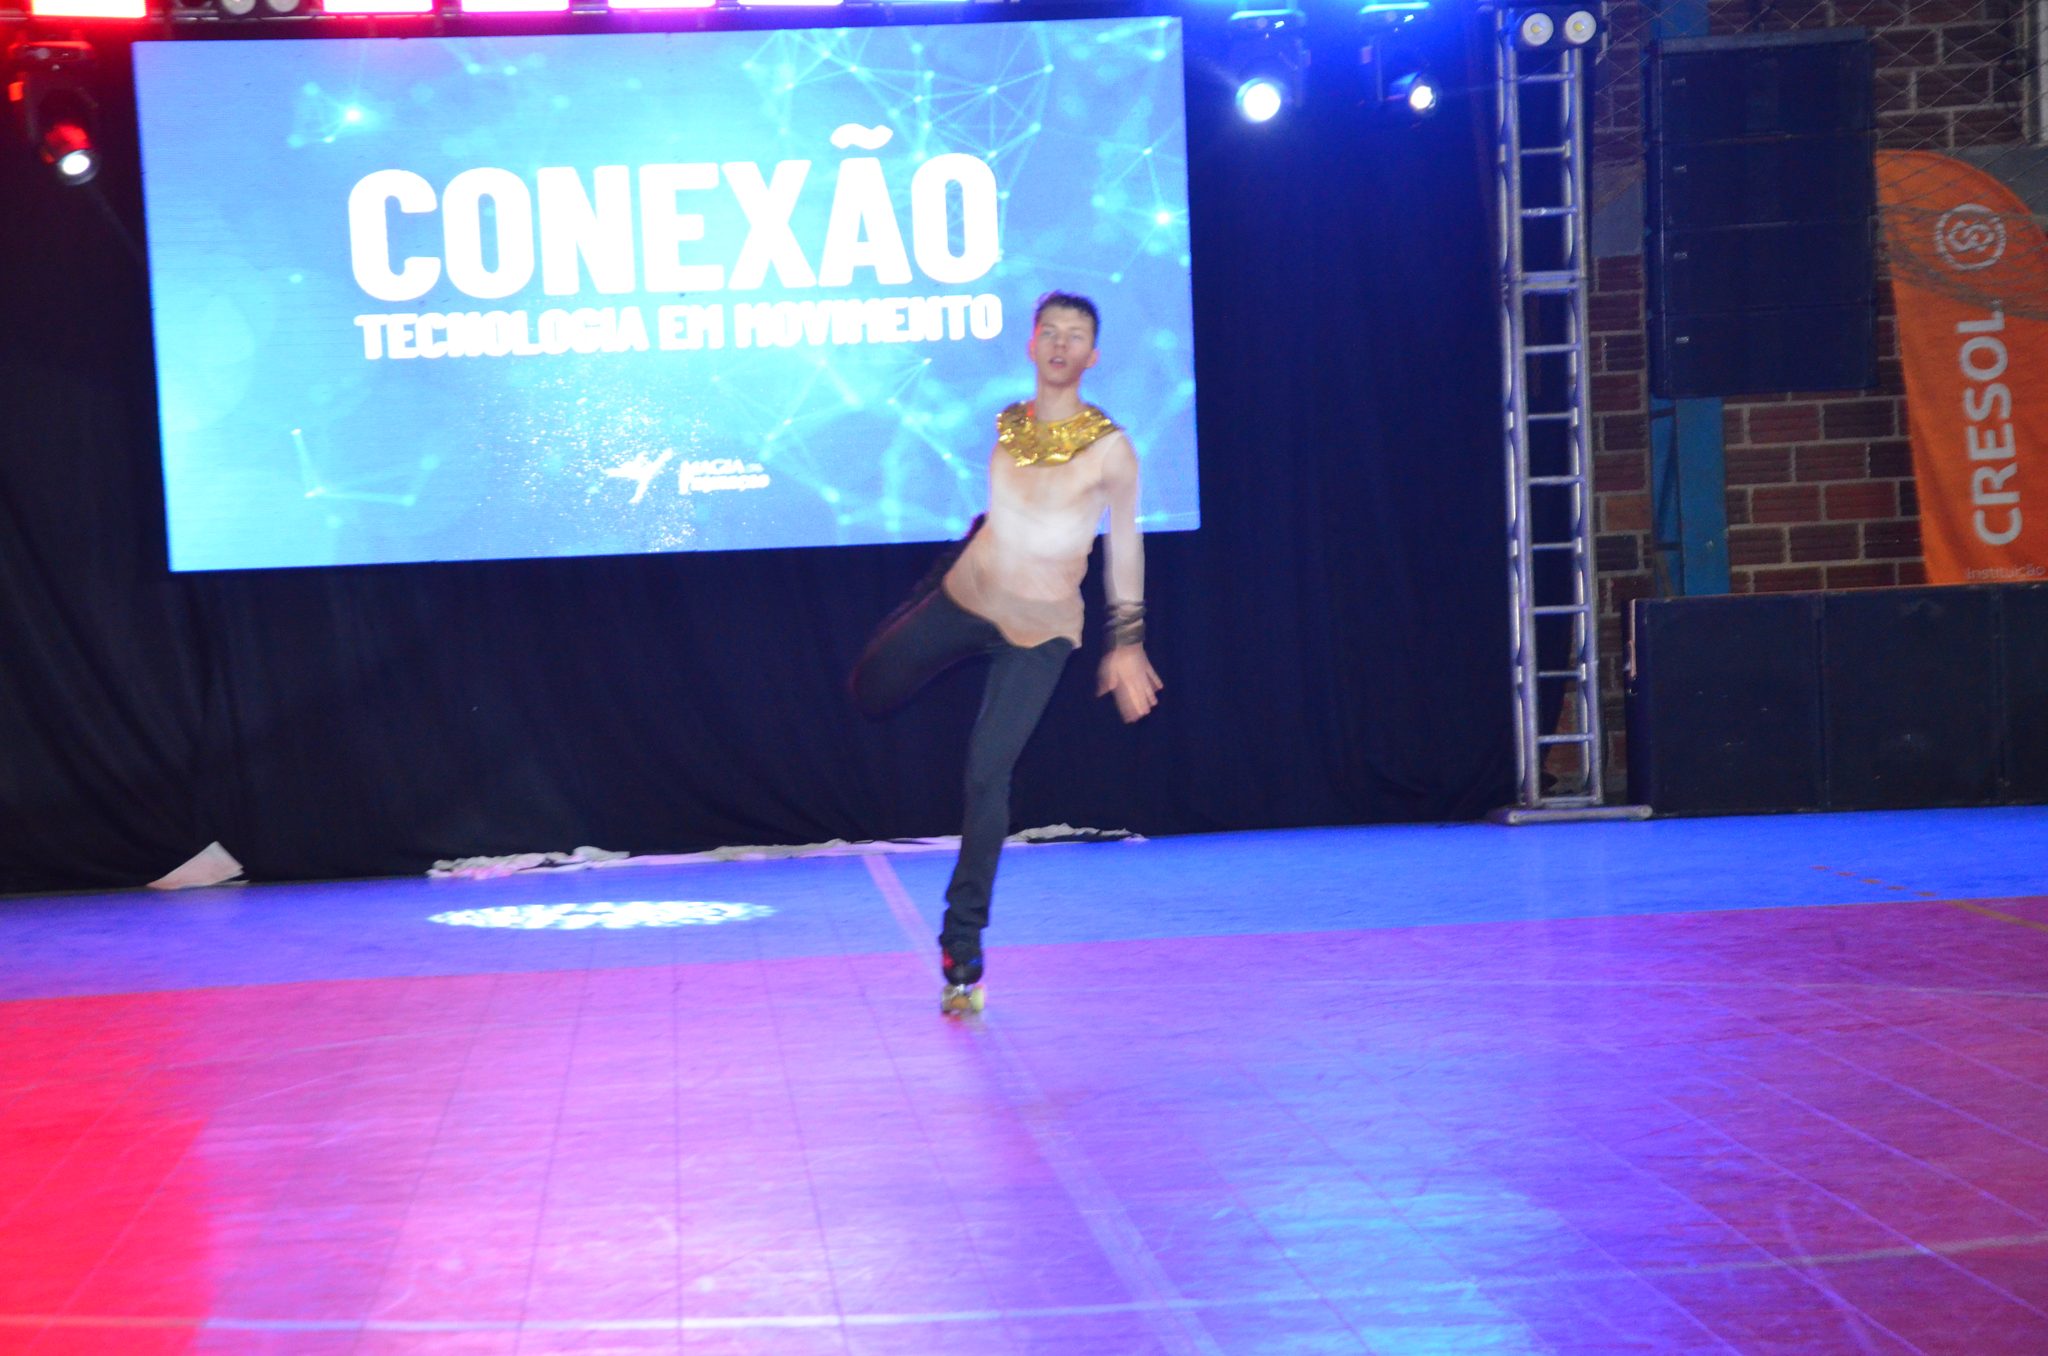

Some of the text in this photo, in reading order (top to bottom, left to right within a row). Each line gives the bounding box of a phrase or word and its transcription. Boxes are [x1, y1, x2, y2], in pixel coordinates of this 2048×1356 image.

[349, 125, 999, 300] CONEXÃO
[354, 294, 1003, 359] TECNOLOGIA EM MOVIMENTO
[1956, 310, 2023, 545] CRESOL
